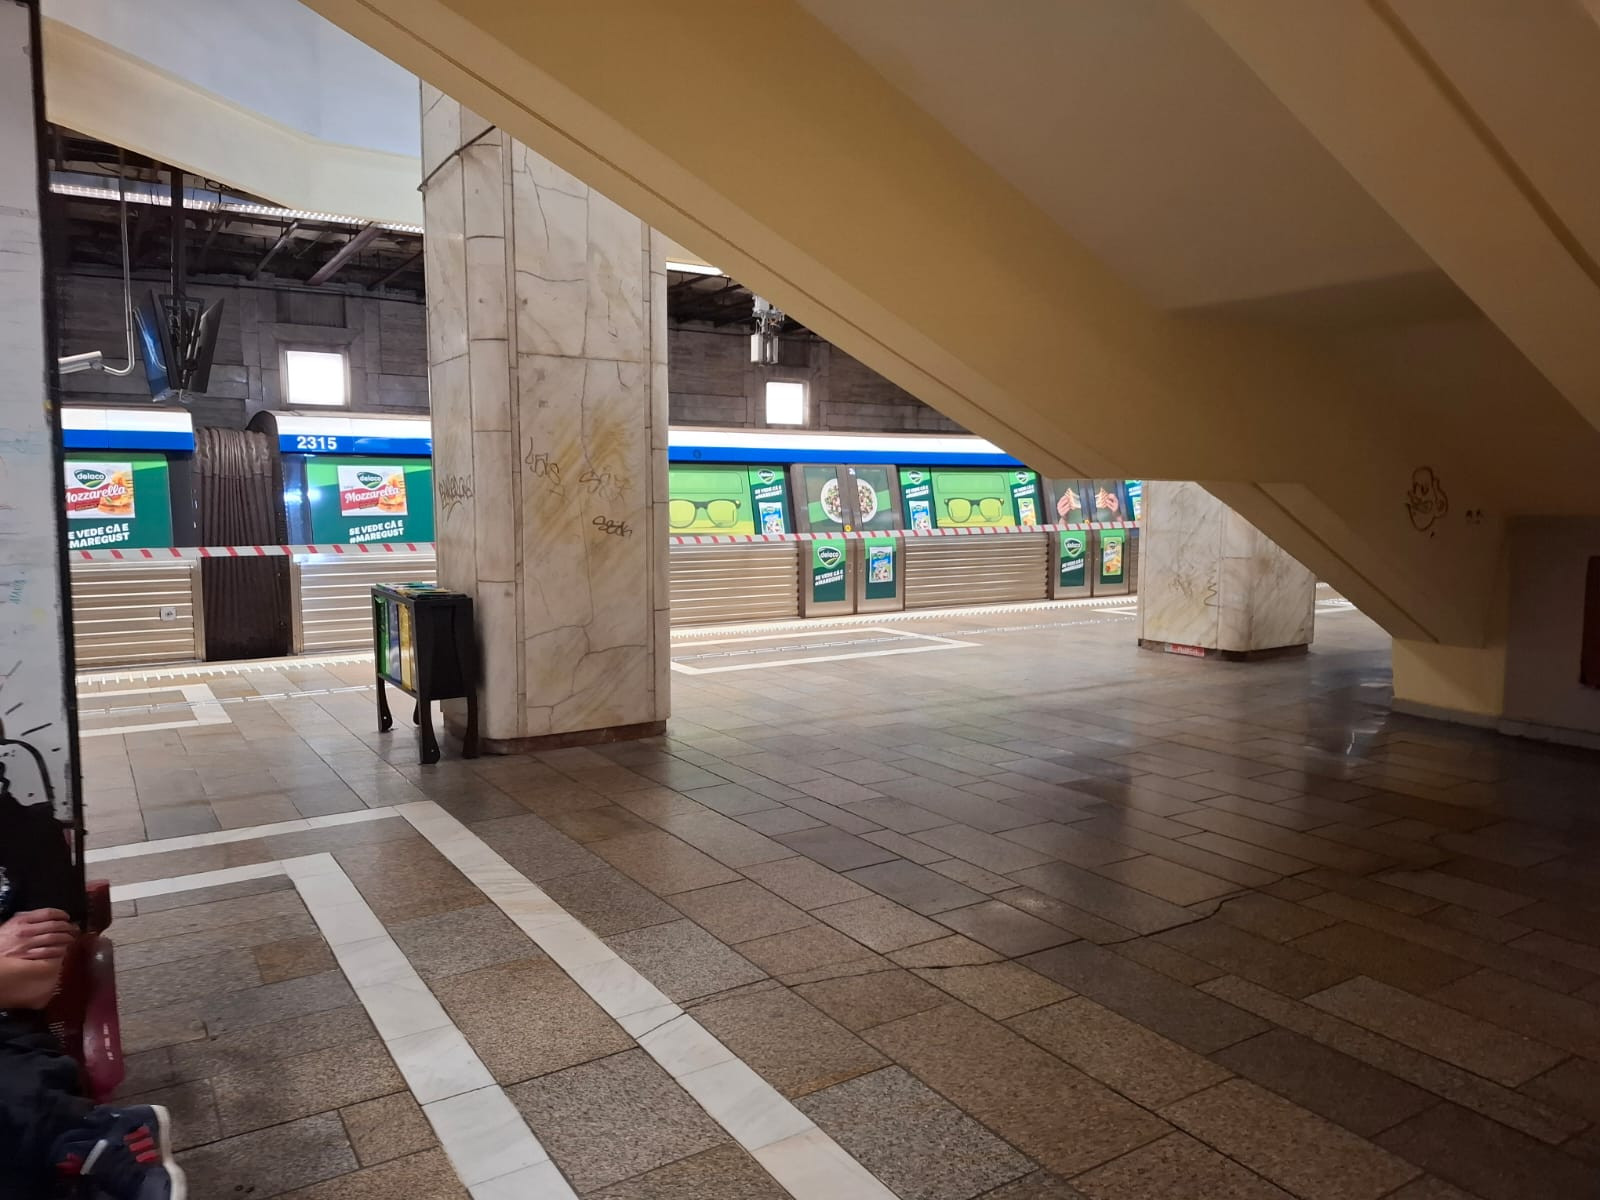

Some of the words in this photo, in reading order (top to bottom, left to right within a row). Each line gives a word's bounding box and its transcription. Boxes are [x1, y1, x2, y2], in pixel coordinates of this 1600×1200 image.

[296, 436, 337, 450] 2315
[76, 472, 105, 480] delaco
[345, 486, 400, 503] Mozzarella
[76, 527, 105, 538] VEDE
[121, 522, 129, 532] E
[349, 527, 360, 536] SE
[361, 523, 384, 534] VEDE
[397, 520, 403, 528] E
[69, 532, 130, 548] MAREGUST
